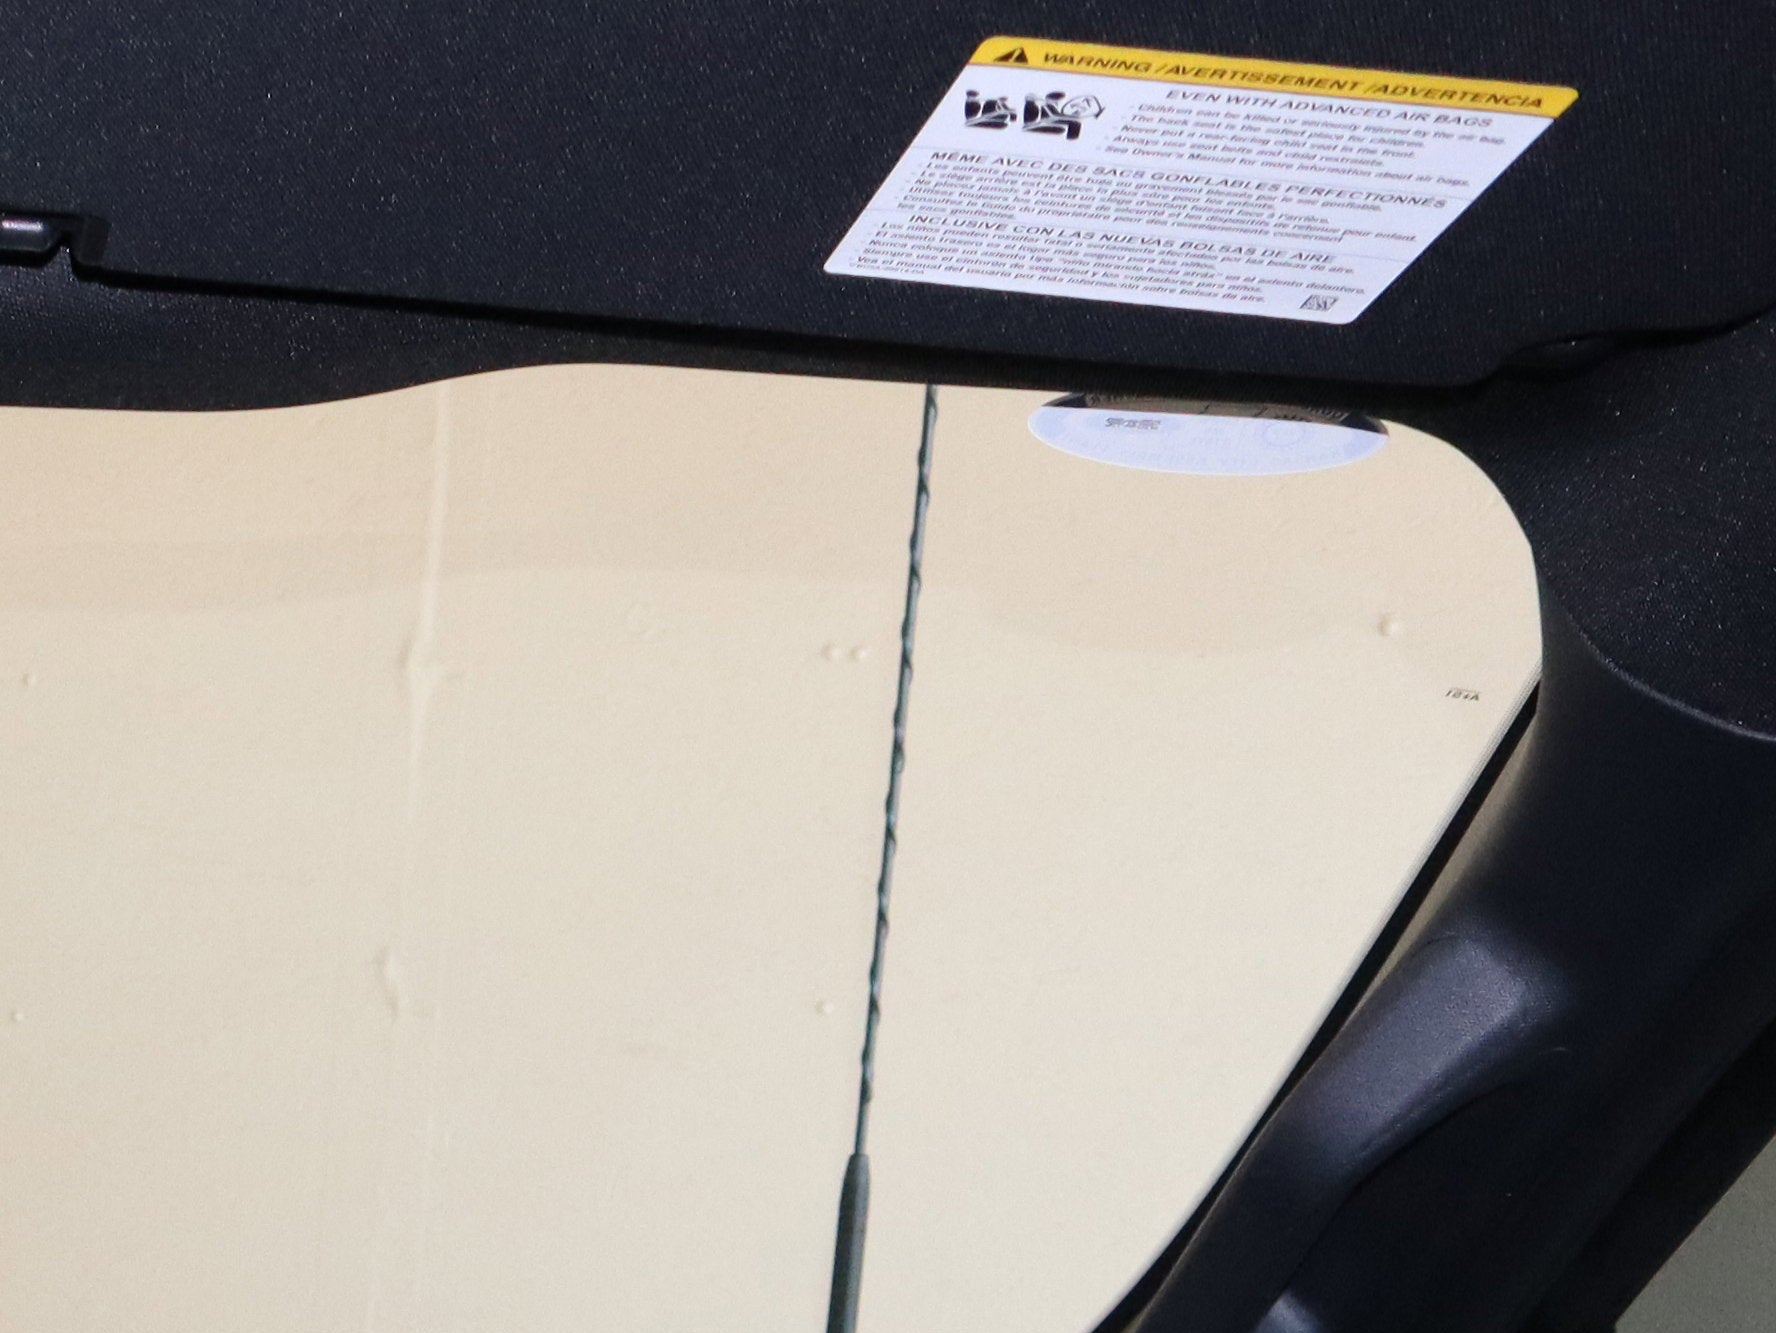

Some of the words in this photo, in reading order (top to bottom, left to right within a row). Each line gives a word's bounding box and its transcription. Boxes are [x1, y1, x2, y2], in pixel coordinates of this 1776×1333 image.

[1038, 52, 1155, 73] WARNING
[1163, 88, 1224, 103] EVEN
[1221, 93, 1280, 108] WITH
[1276, 98, 1394, 119] ADVANCED
[1391, 109, 1434, 122] AIR
[1430, 112, 1496, 128] BAGS
[989, 155, 1046, 170] AVEC
[1089, 163, 1151, 180] SACS
[1146, 170, 1284, 193] GONFLABLES
[906, 213, 1010, 232] INCLUSIVE
[1097, 232, 1178, 248] NUEVAS
[1176, 239, 1260, 257] BOLSAS
[1287, 251, 1338, 264] AIRE
